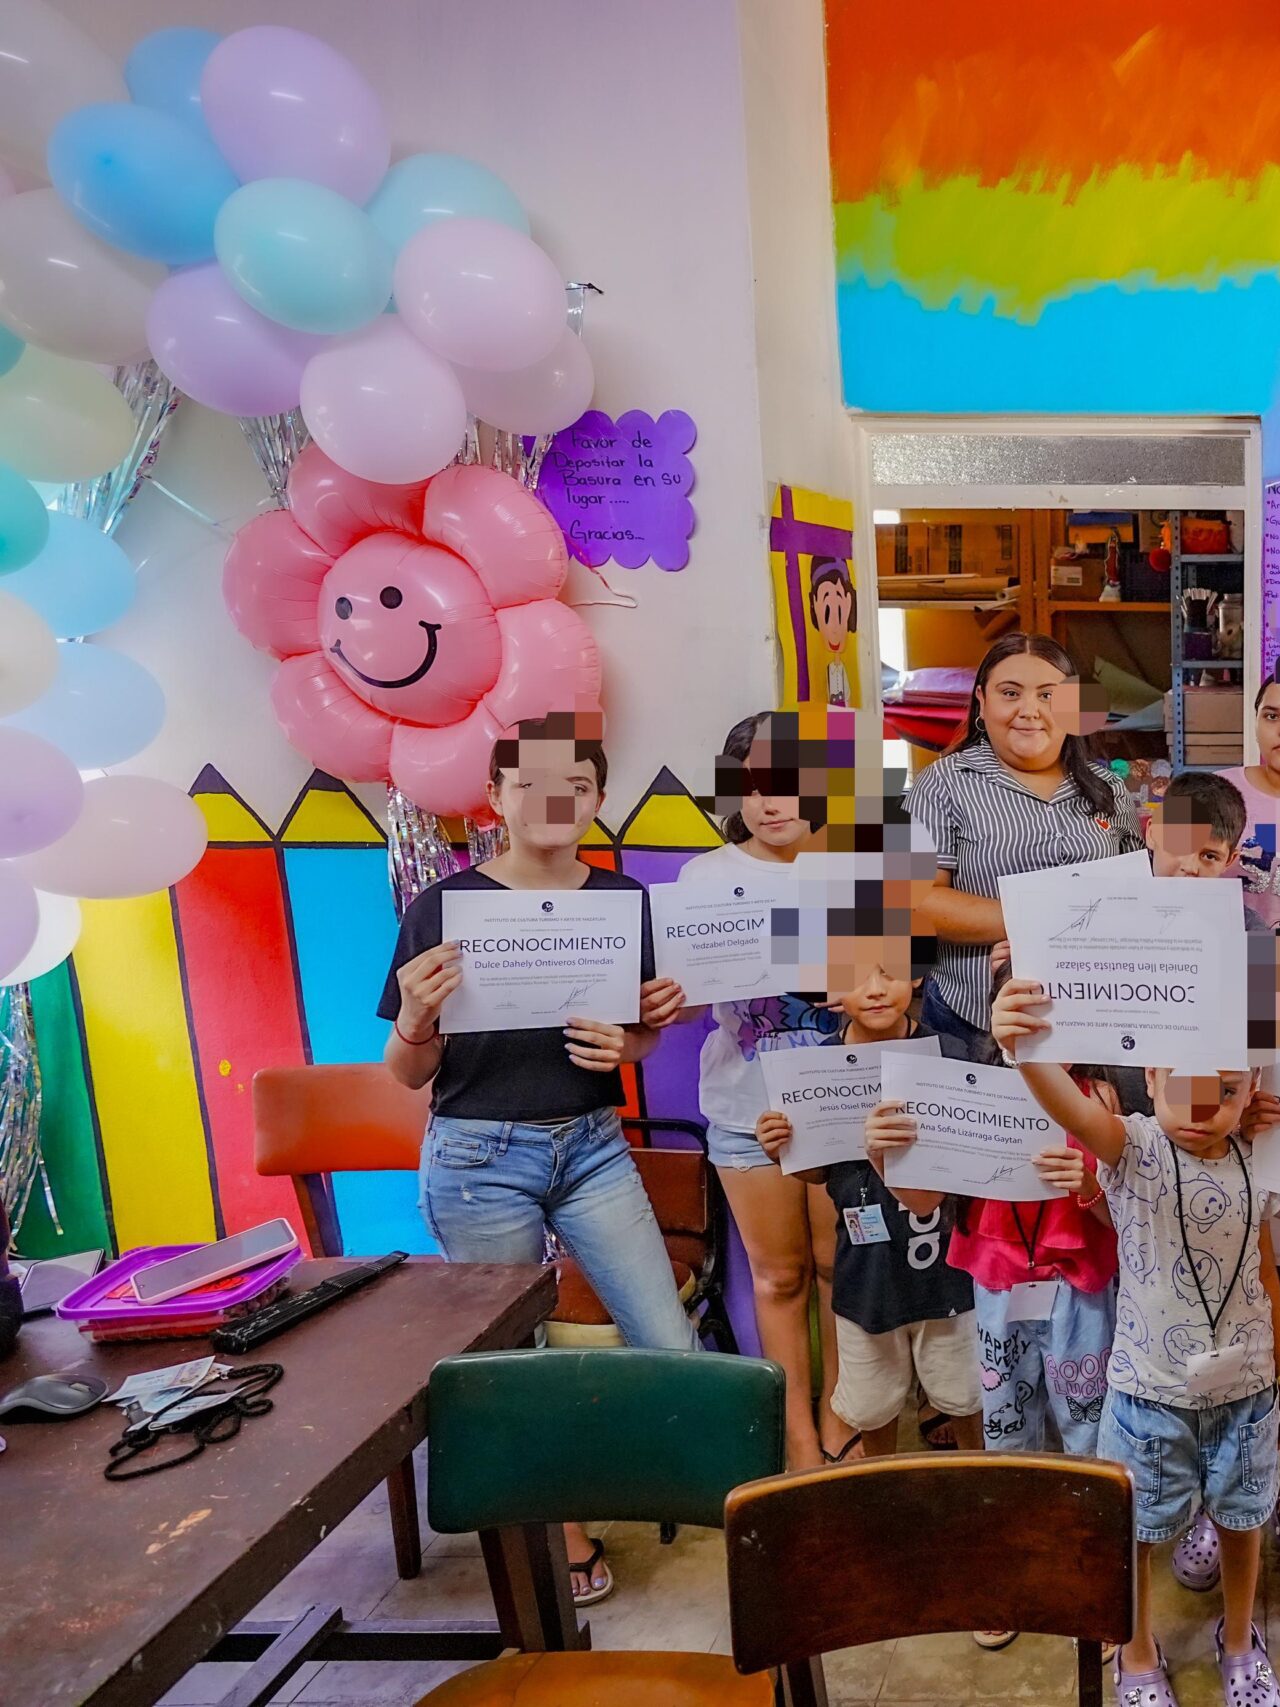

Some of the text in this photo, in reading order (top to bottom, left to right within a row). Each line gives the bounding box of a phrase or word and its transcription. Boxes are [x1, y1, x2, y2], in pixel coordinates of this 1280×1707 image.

[571, 430, 653, 449] Favor de
[552, 451, 654, 471] Depositar la
[562, 469, 622, 486] Basura
[634, 474, 656, 487] en
[666, 918, 765, 939] RECONOCIM
[460, 936, 626, 953] RECONOCIMIENTO
[691, 937, 759, 950] Yedzabel Delgado
[474, 956, 614, 970] Dulce Dahely Ontiveros Olmedas
[1056, 961, 1092, 971] Salazar
[1094, 961, 1135, 972] Bautista
[1159, 963, 1198, 974] Daniela
[781, 1082, 881, 1105] RECONOCIM
[841, 1102, 860, 1110] Osiel
[895, 1101, 1050, 1131] RECONOCIMIENTO
[920, 1122, 936, 1132] Ana
[957, 1127, 993, 1141] Lizárraga
[994, 1134, 1023, 1145] Gaytan
[977, 1322, 1019, 1354] HAPPY
[985, 1340, 1031, 1367] EVERY
[1054, 1375, 1109, 1399] LUCK
